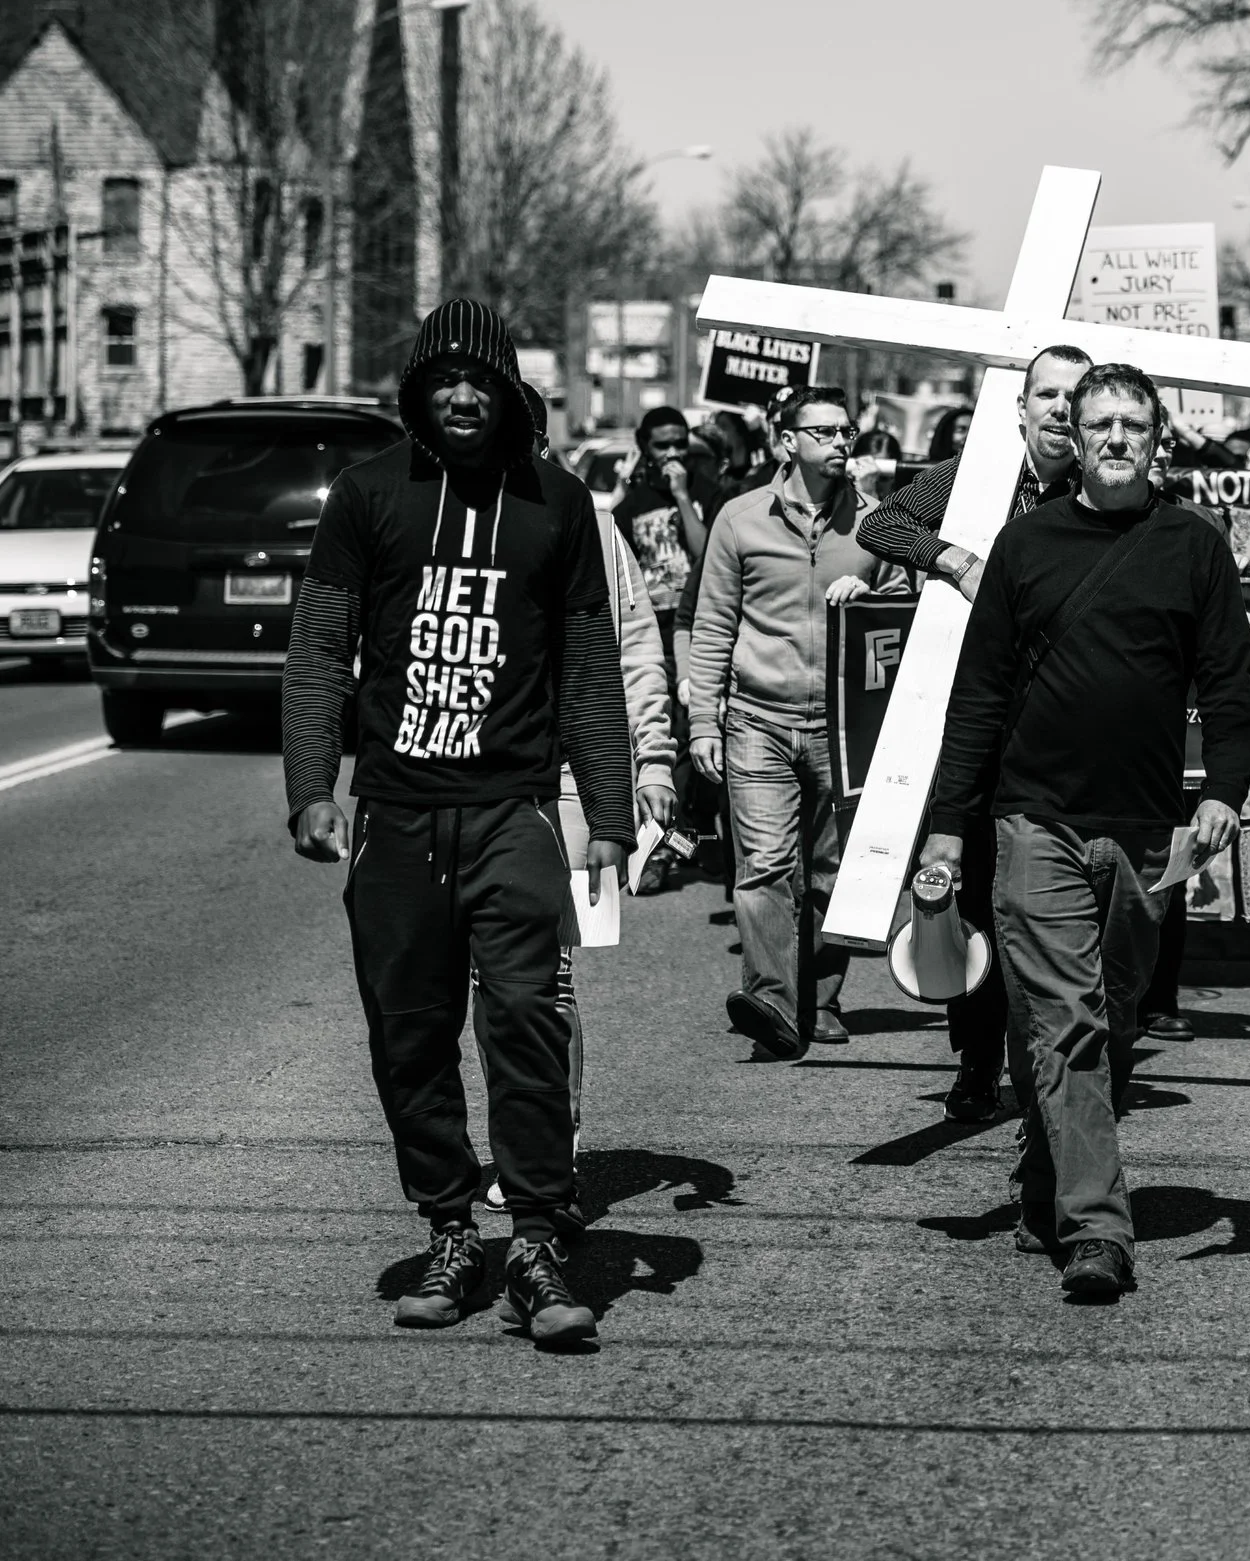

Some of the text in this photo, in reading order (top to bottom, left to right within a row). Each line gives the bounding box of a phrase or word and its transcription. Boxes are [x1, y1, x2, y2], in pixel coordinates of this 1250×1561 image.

[1101, 251, 1200, 270] ALL WHITE
[1120, 275, 1174, 294] JURY
[1106, 303, 1198, 321] NOT PRE-
[715, 330, 810, 364] BLACK LIVES
[724, 355, 789, 386] MATTER
[461, 507, 477, 558] I
[416, 566, 507, 615] MET
[410, 613, 507, 668] GOD,
[406, 661, 495, 711] SHE'S
[394, 704, 488, 759] BLACK
